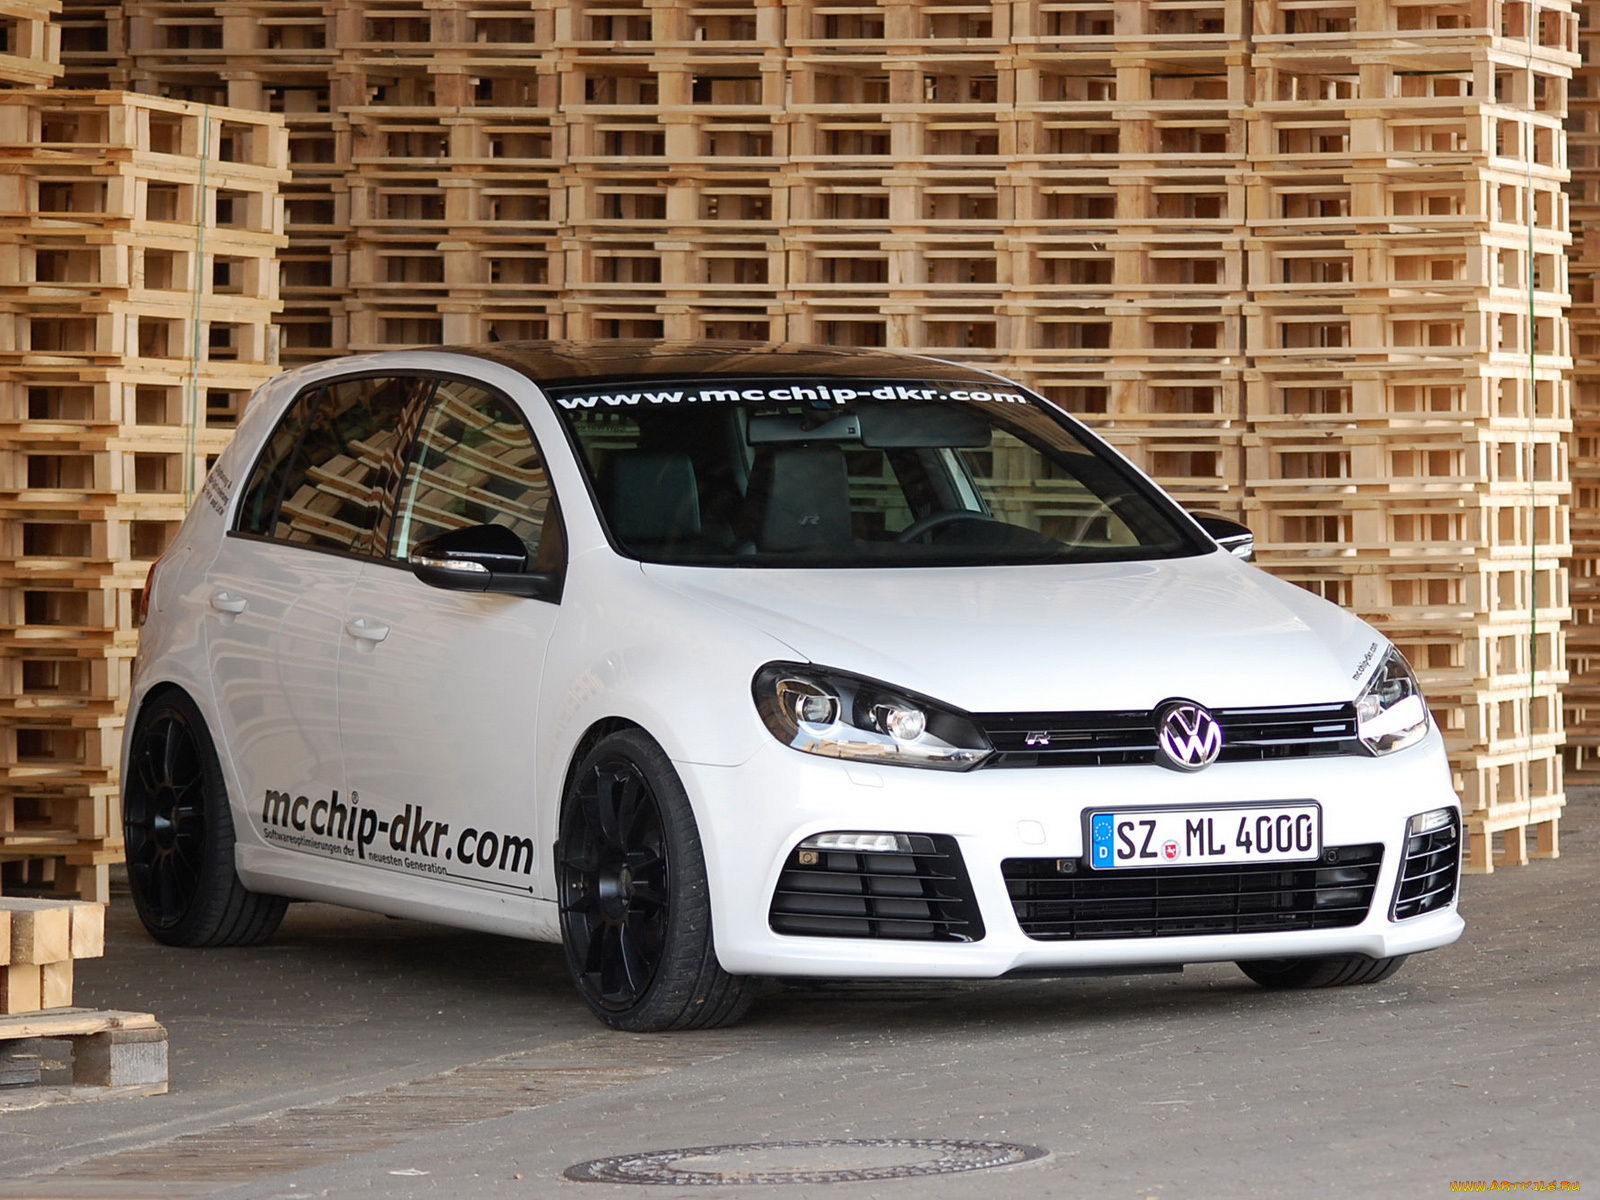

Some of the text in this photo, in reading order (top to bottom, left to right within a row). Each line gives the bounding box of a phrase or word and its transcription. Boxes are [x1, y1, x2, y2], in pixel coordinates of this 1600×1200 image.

[556, 385, 1027, 409] www.mcchip-dkr.com
[263, 828, 447, 875] Softwareoptimierungen der neuesten Generation
[1099, 846, 1108, 859] D
[1117, 814, 1312, 859] SZ ML 4000
